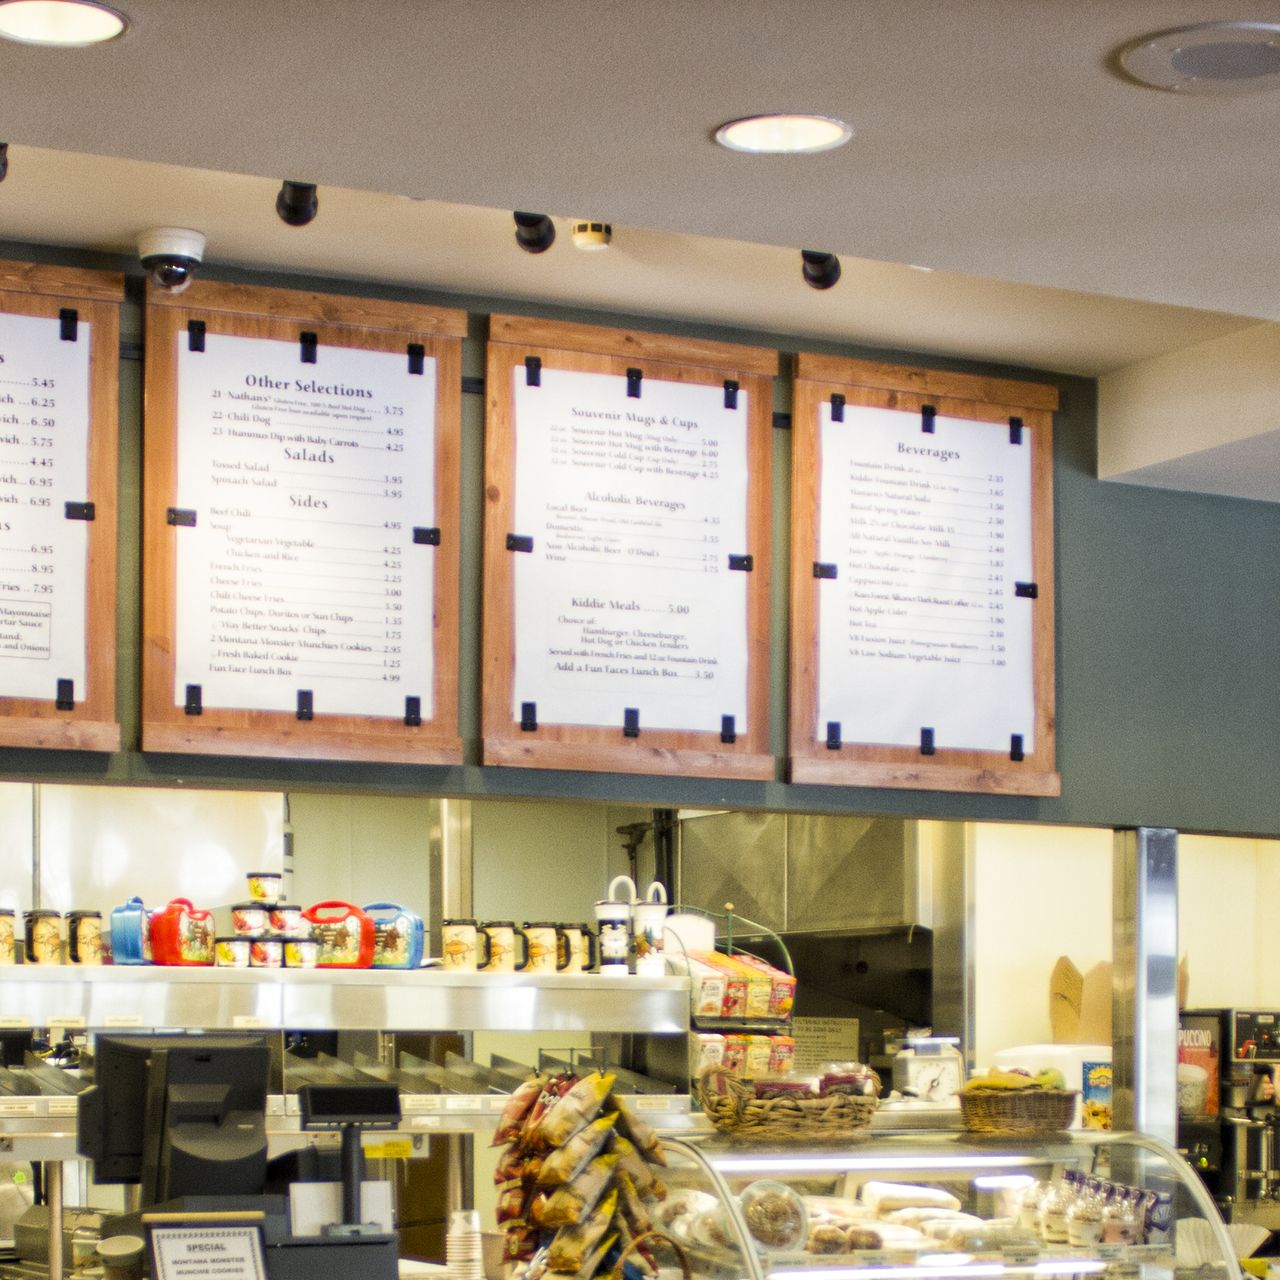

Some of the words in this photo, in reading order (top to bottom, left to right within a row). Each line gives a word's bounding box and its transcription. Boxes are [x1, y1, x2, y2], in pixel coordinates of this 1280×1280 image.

[33, 377, 55, 389] 5.45
[245, 375, 291, 390] Other
[295, 380, 373, 399] Selections
[31, 398, 56, 408] 6.25
[30, 417, 56, 428] 6.50
[212, 410, 224, 420] 22
[227, 412, 250, 422] Chili
[252, 414, 271, 427] Dog
[387, 428, 404, 437] 4.95
[571, 407, 622, 421] Souvenir
[626, 412, 656, 428] Mugs
[659, 416, 669, 426] &
[671, 417, 699, 432] Cups
[284, 448, 335, 464] Salads
[897, 442, 961, 462] Beverages
[289, 494, 328, 510] Sides
[635, 496, 686, 512] Beverages
[571, 598, 605, 609] Kiddie
[609, 600, 641, 611] Meals
[669, 604, 690, 615] 5.00
[1178, 1029, 1212, 1048] PUCCINO
[186, 1243, 226, 1252] SPECIAL
